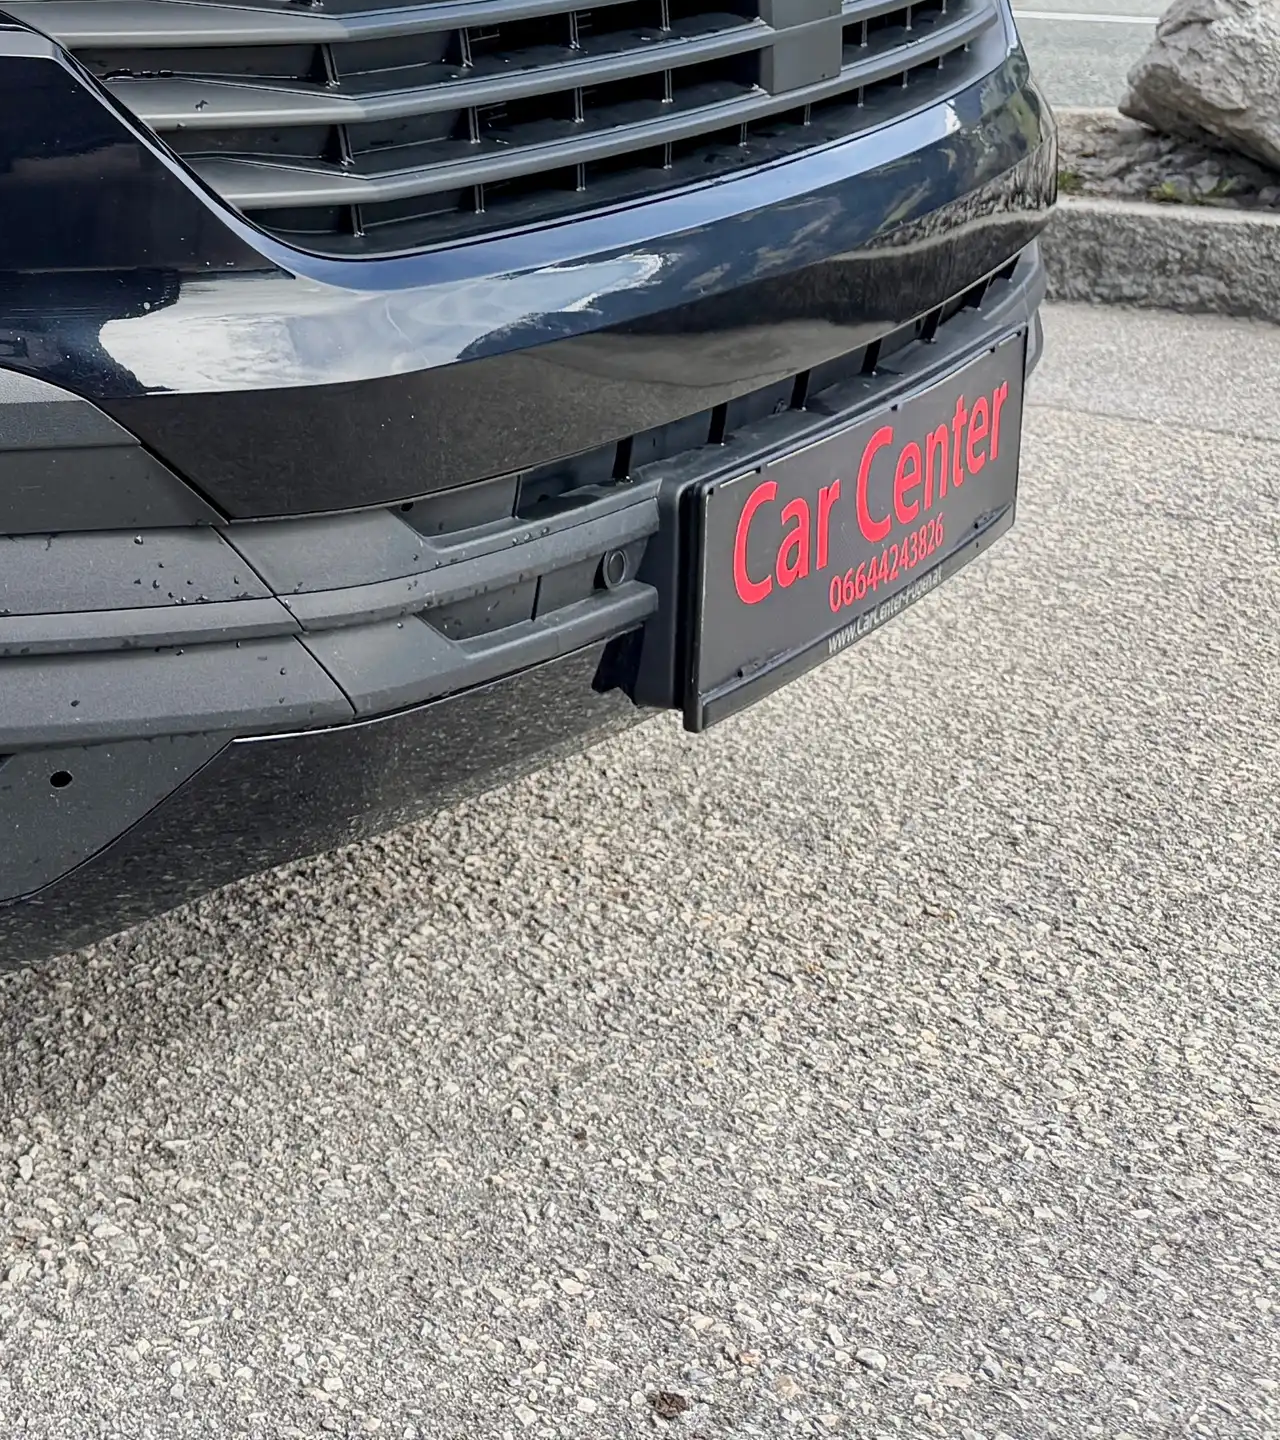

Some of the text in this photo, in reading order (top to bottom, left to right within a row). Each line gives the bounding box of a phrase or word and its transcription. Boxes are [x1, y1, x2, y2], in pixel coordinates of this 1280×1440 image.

[732, 380, 1009, 606] Car Center
[829, 511, 945, 613] 06644243826
